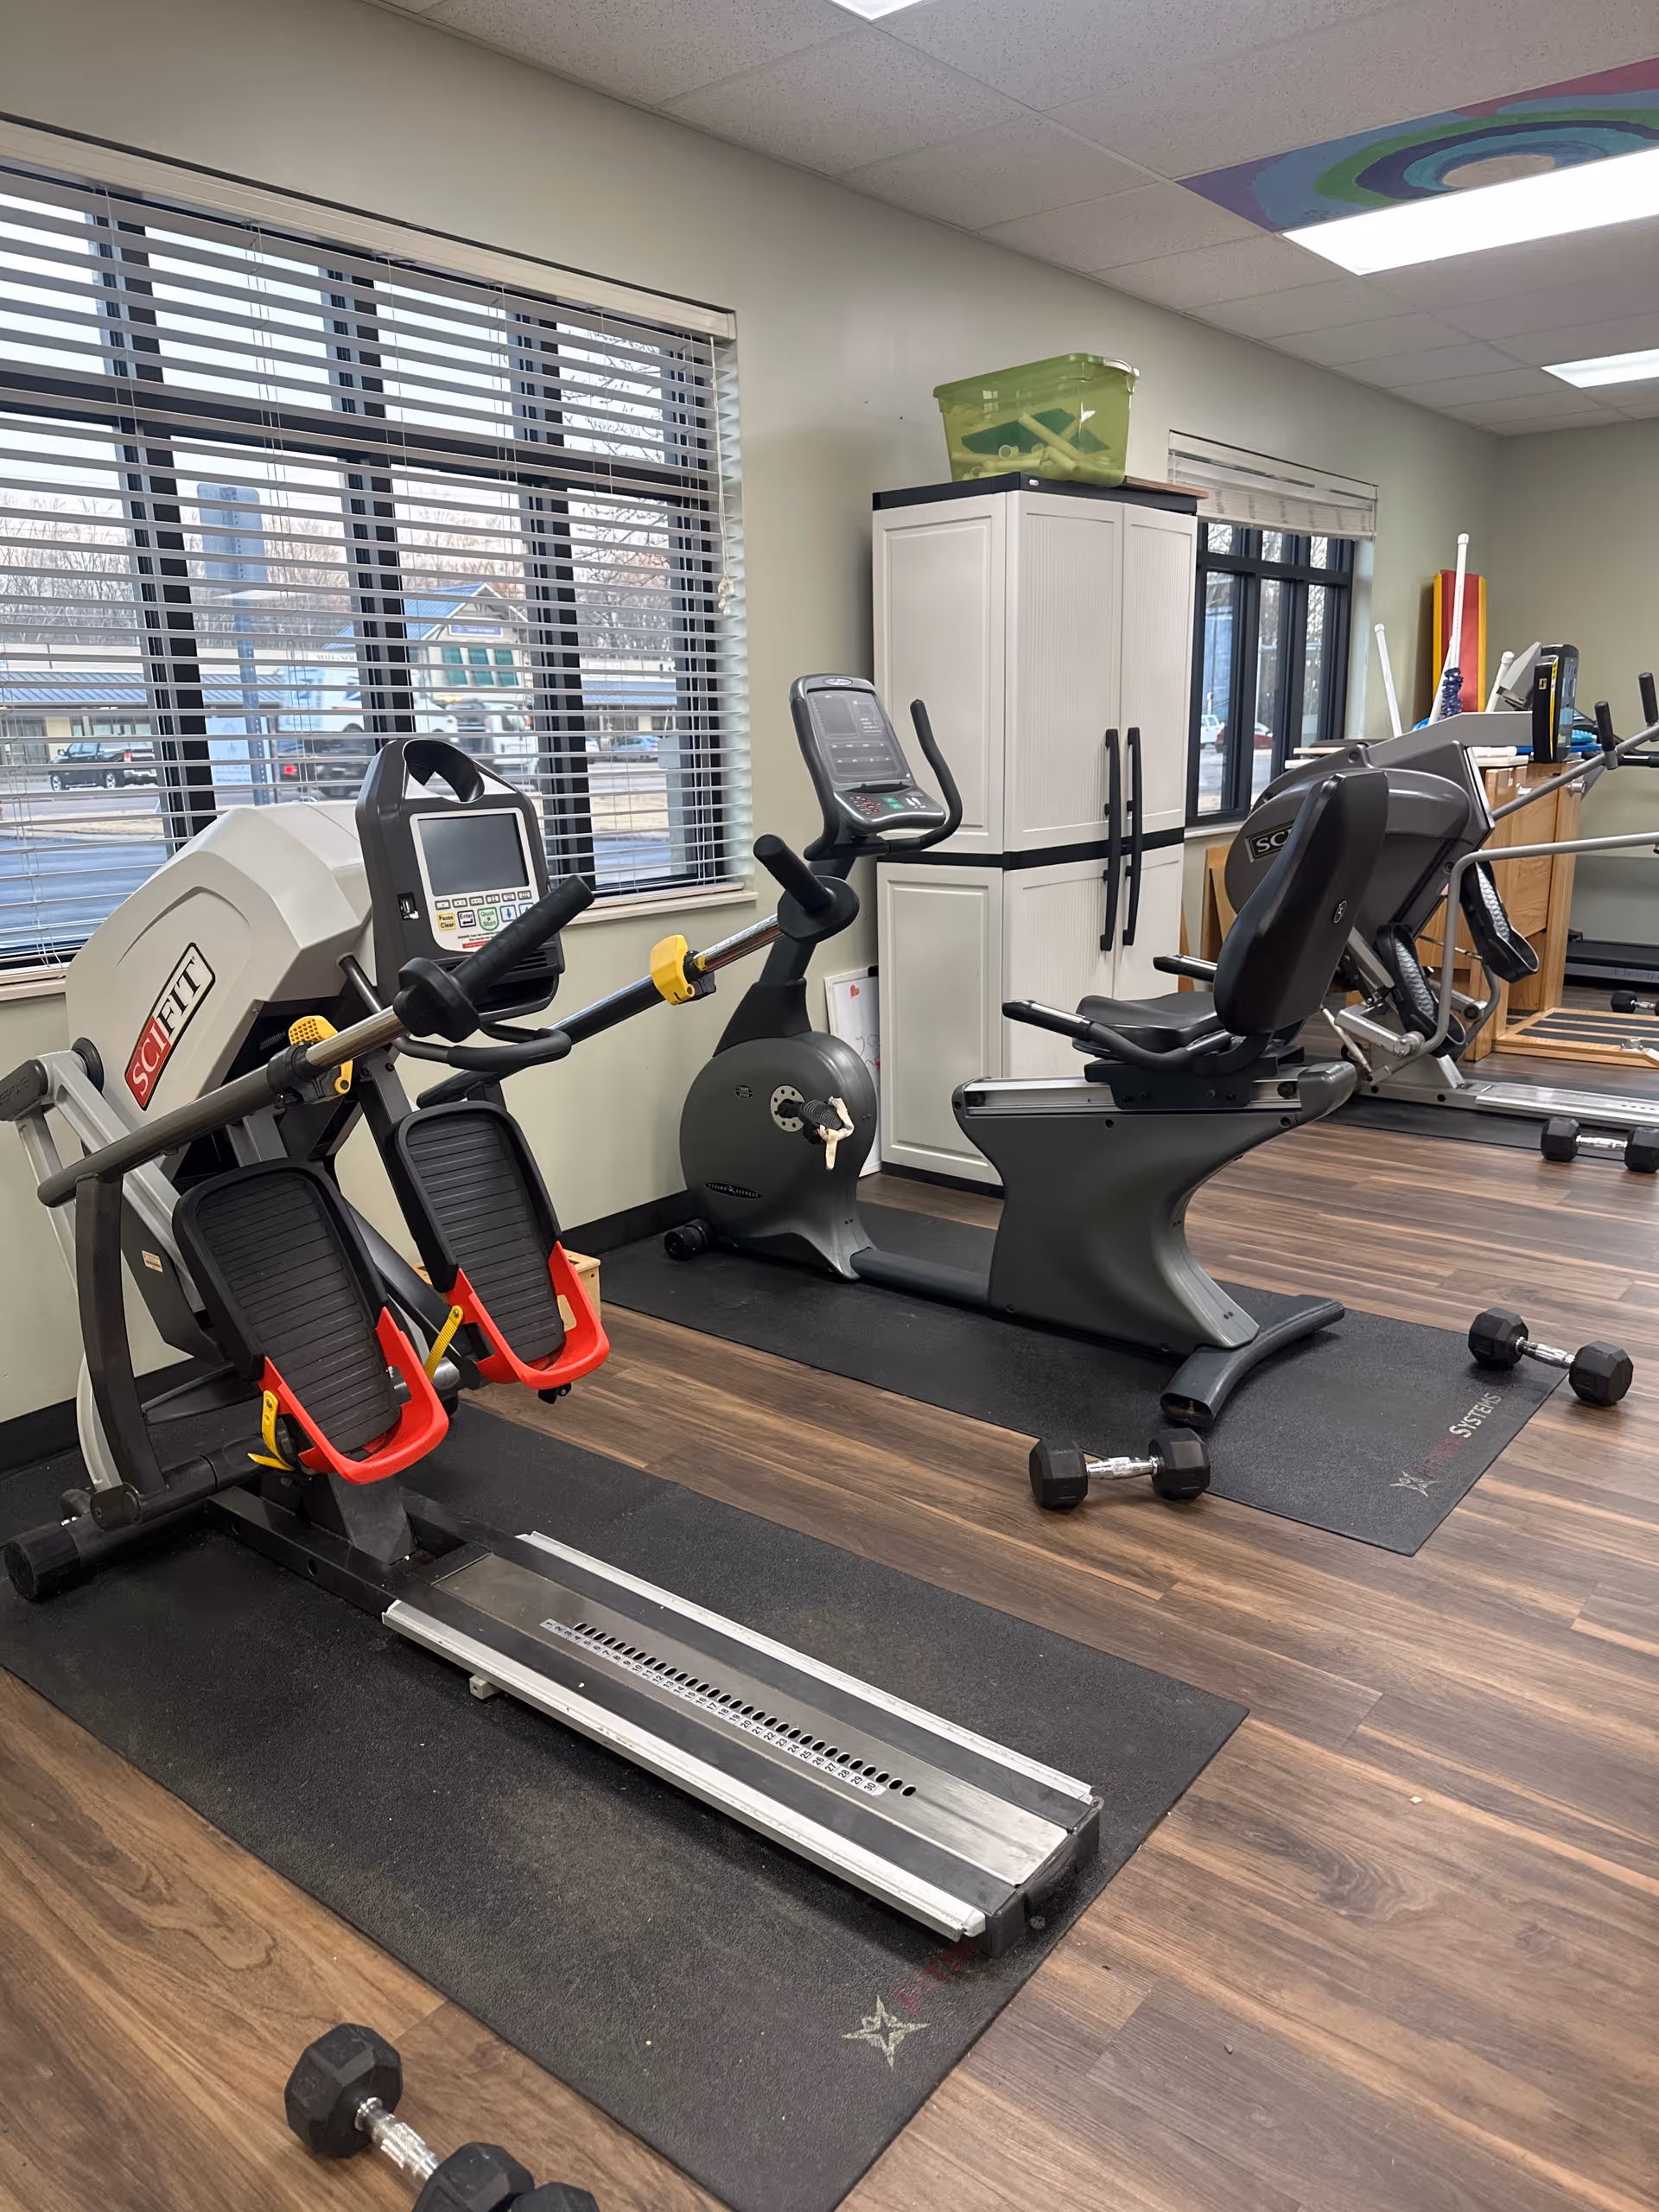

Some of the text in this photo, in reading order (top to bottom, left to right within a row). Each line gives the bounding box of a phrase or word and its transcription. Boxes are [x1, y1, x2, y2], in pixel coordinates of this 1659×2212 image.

[1256, 830, 1293, 853] SC
[132, 958, 201, 1096] SCIFIT
[1449, 1392, 1503, 1439] SYSTEMS
[741, 1719, 752, 1728] 20
[752, 1726, 764, 1734] 21
[763, 1732, 776, 1740] 22
[775, 1738, 787, 1747] 23
[787, 1744, 800, 1753] 24
[800, 1750, 812, 1759] 25
[812, 1756, 824, 1765] 26
[824, 1763, 836, 1771] 27
[837, 1769, 850, 1778] 28
[850, 1776, 863, 1785] 29
[863, 1782, 876, 1791] 30
